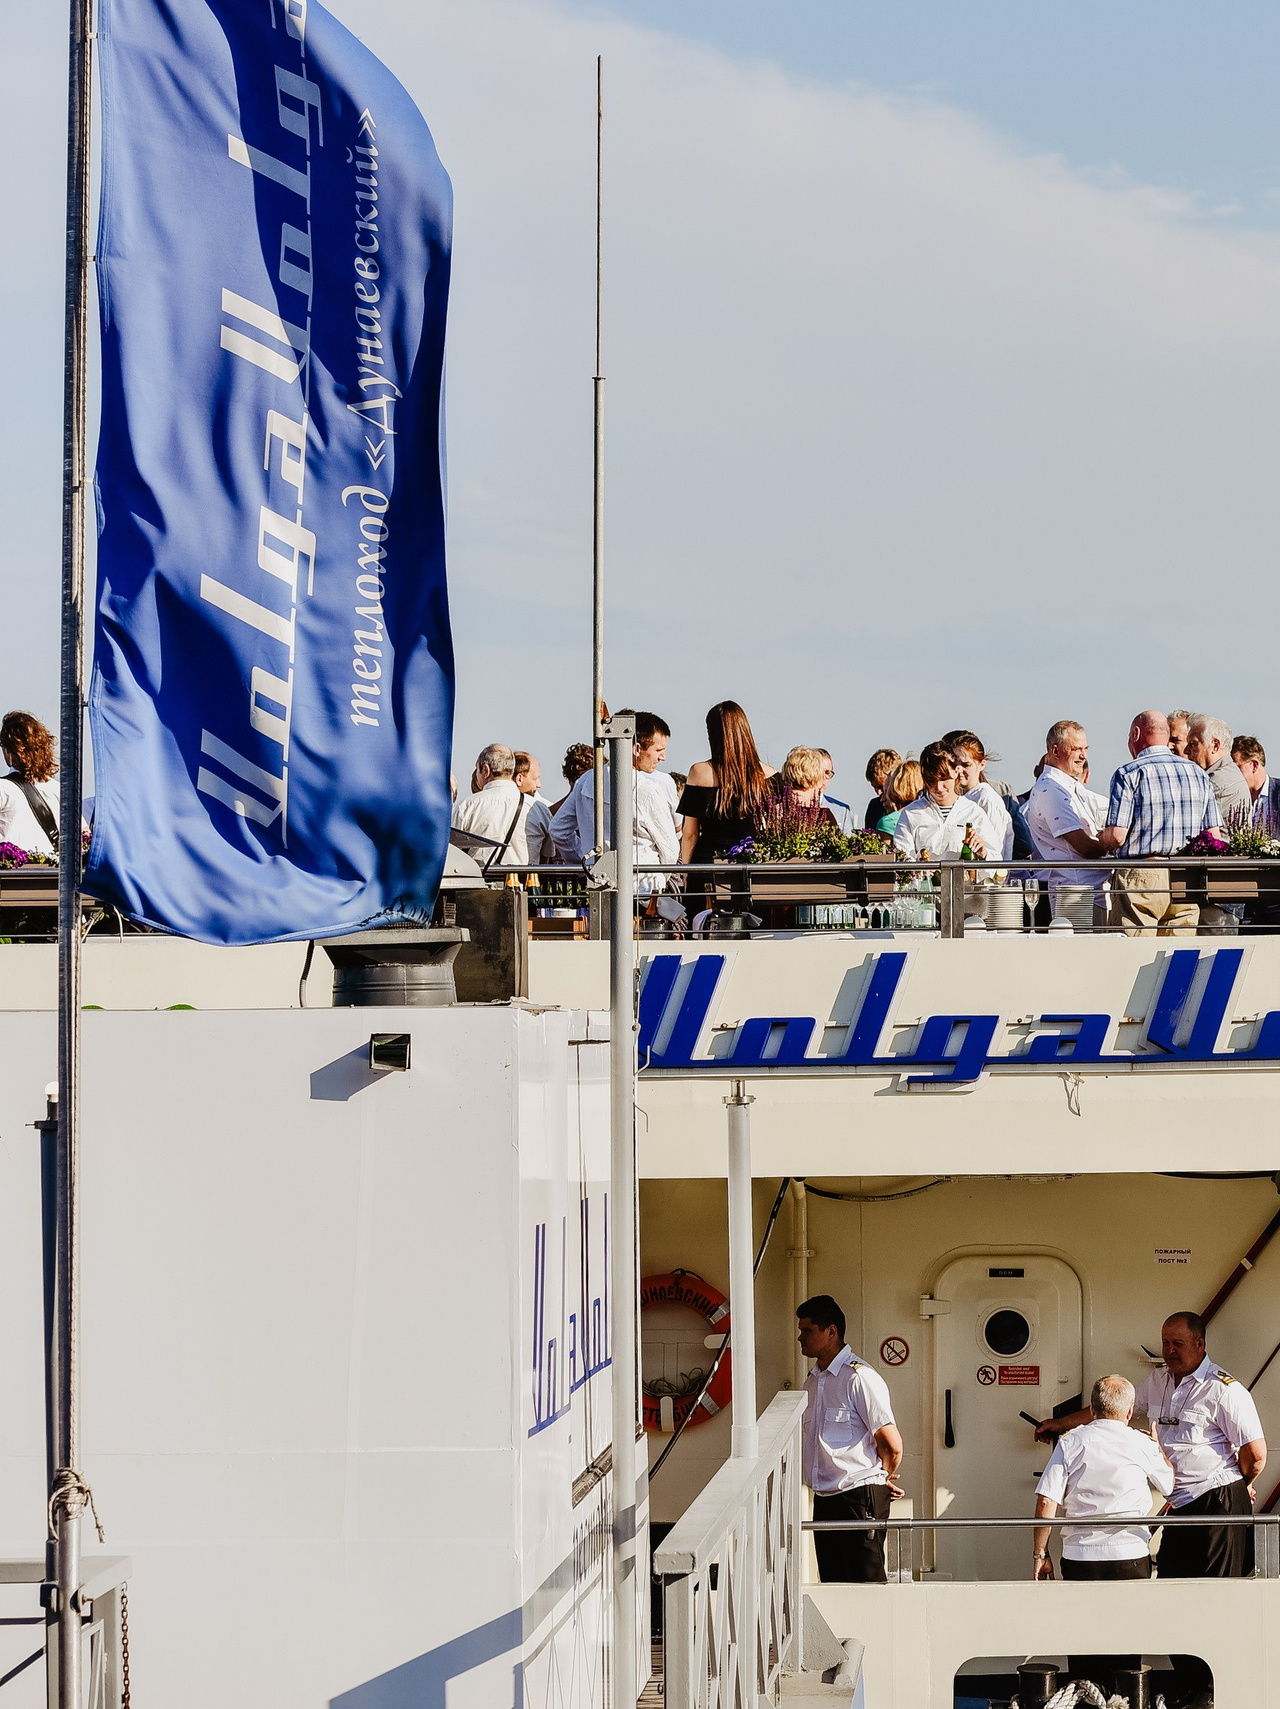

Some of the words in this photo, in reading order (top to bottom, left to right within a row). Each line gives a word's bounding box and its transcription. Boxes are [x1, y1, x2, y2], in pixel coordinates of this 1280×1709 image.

[346, 107, 404, 471] «Дунаевский»
[341, 485, 390, 727] теплоход
[640, 1285, 721, 1319] УНАЕВСКИЙ
